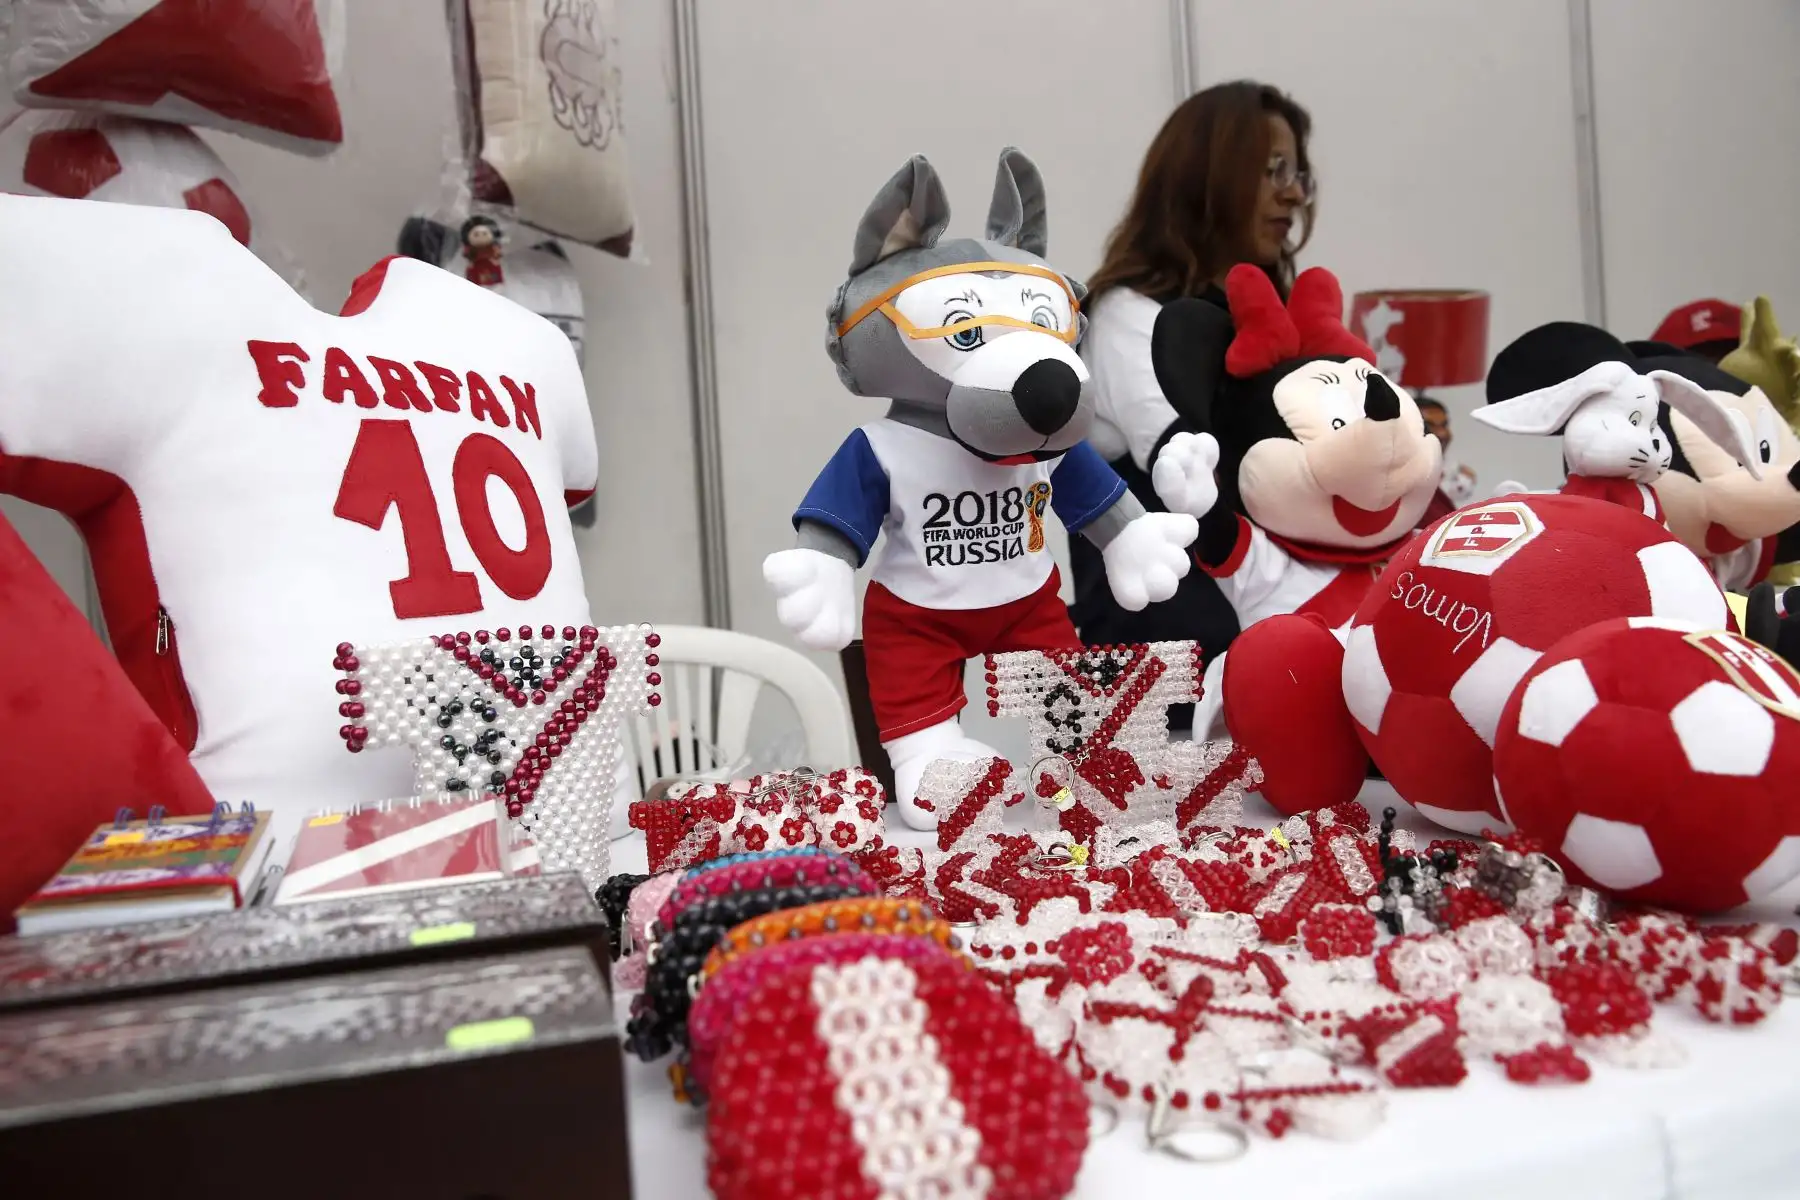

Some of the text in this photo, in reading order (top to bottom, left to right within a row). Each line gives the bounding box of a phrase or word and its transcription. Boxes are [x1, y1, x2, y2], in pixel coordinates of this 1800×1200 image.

[247, 339, 542, 440] FARFAN
[333, 418, 552, 619] 10
[922, 486, 1025, 529] 2018
[923, 521, 1025, 543] FIFA WORLD CUP
[925, 536, 1025, 567] RUSSIA
[1390, 571, 1492, 654] Vamos
